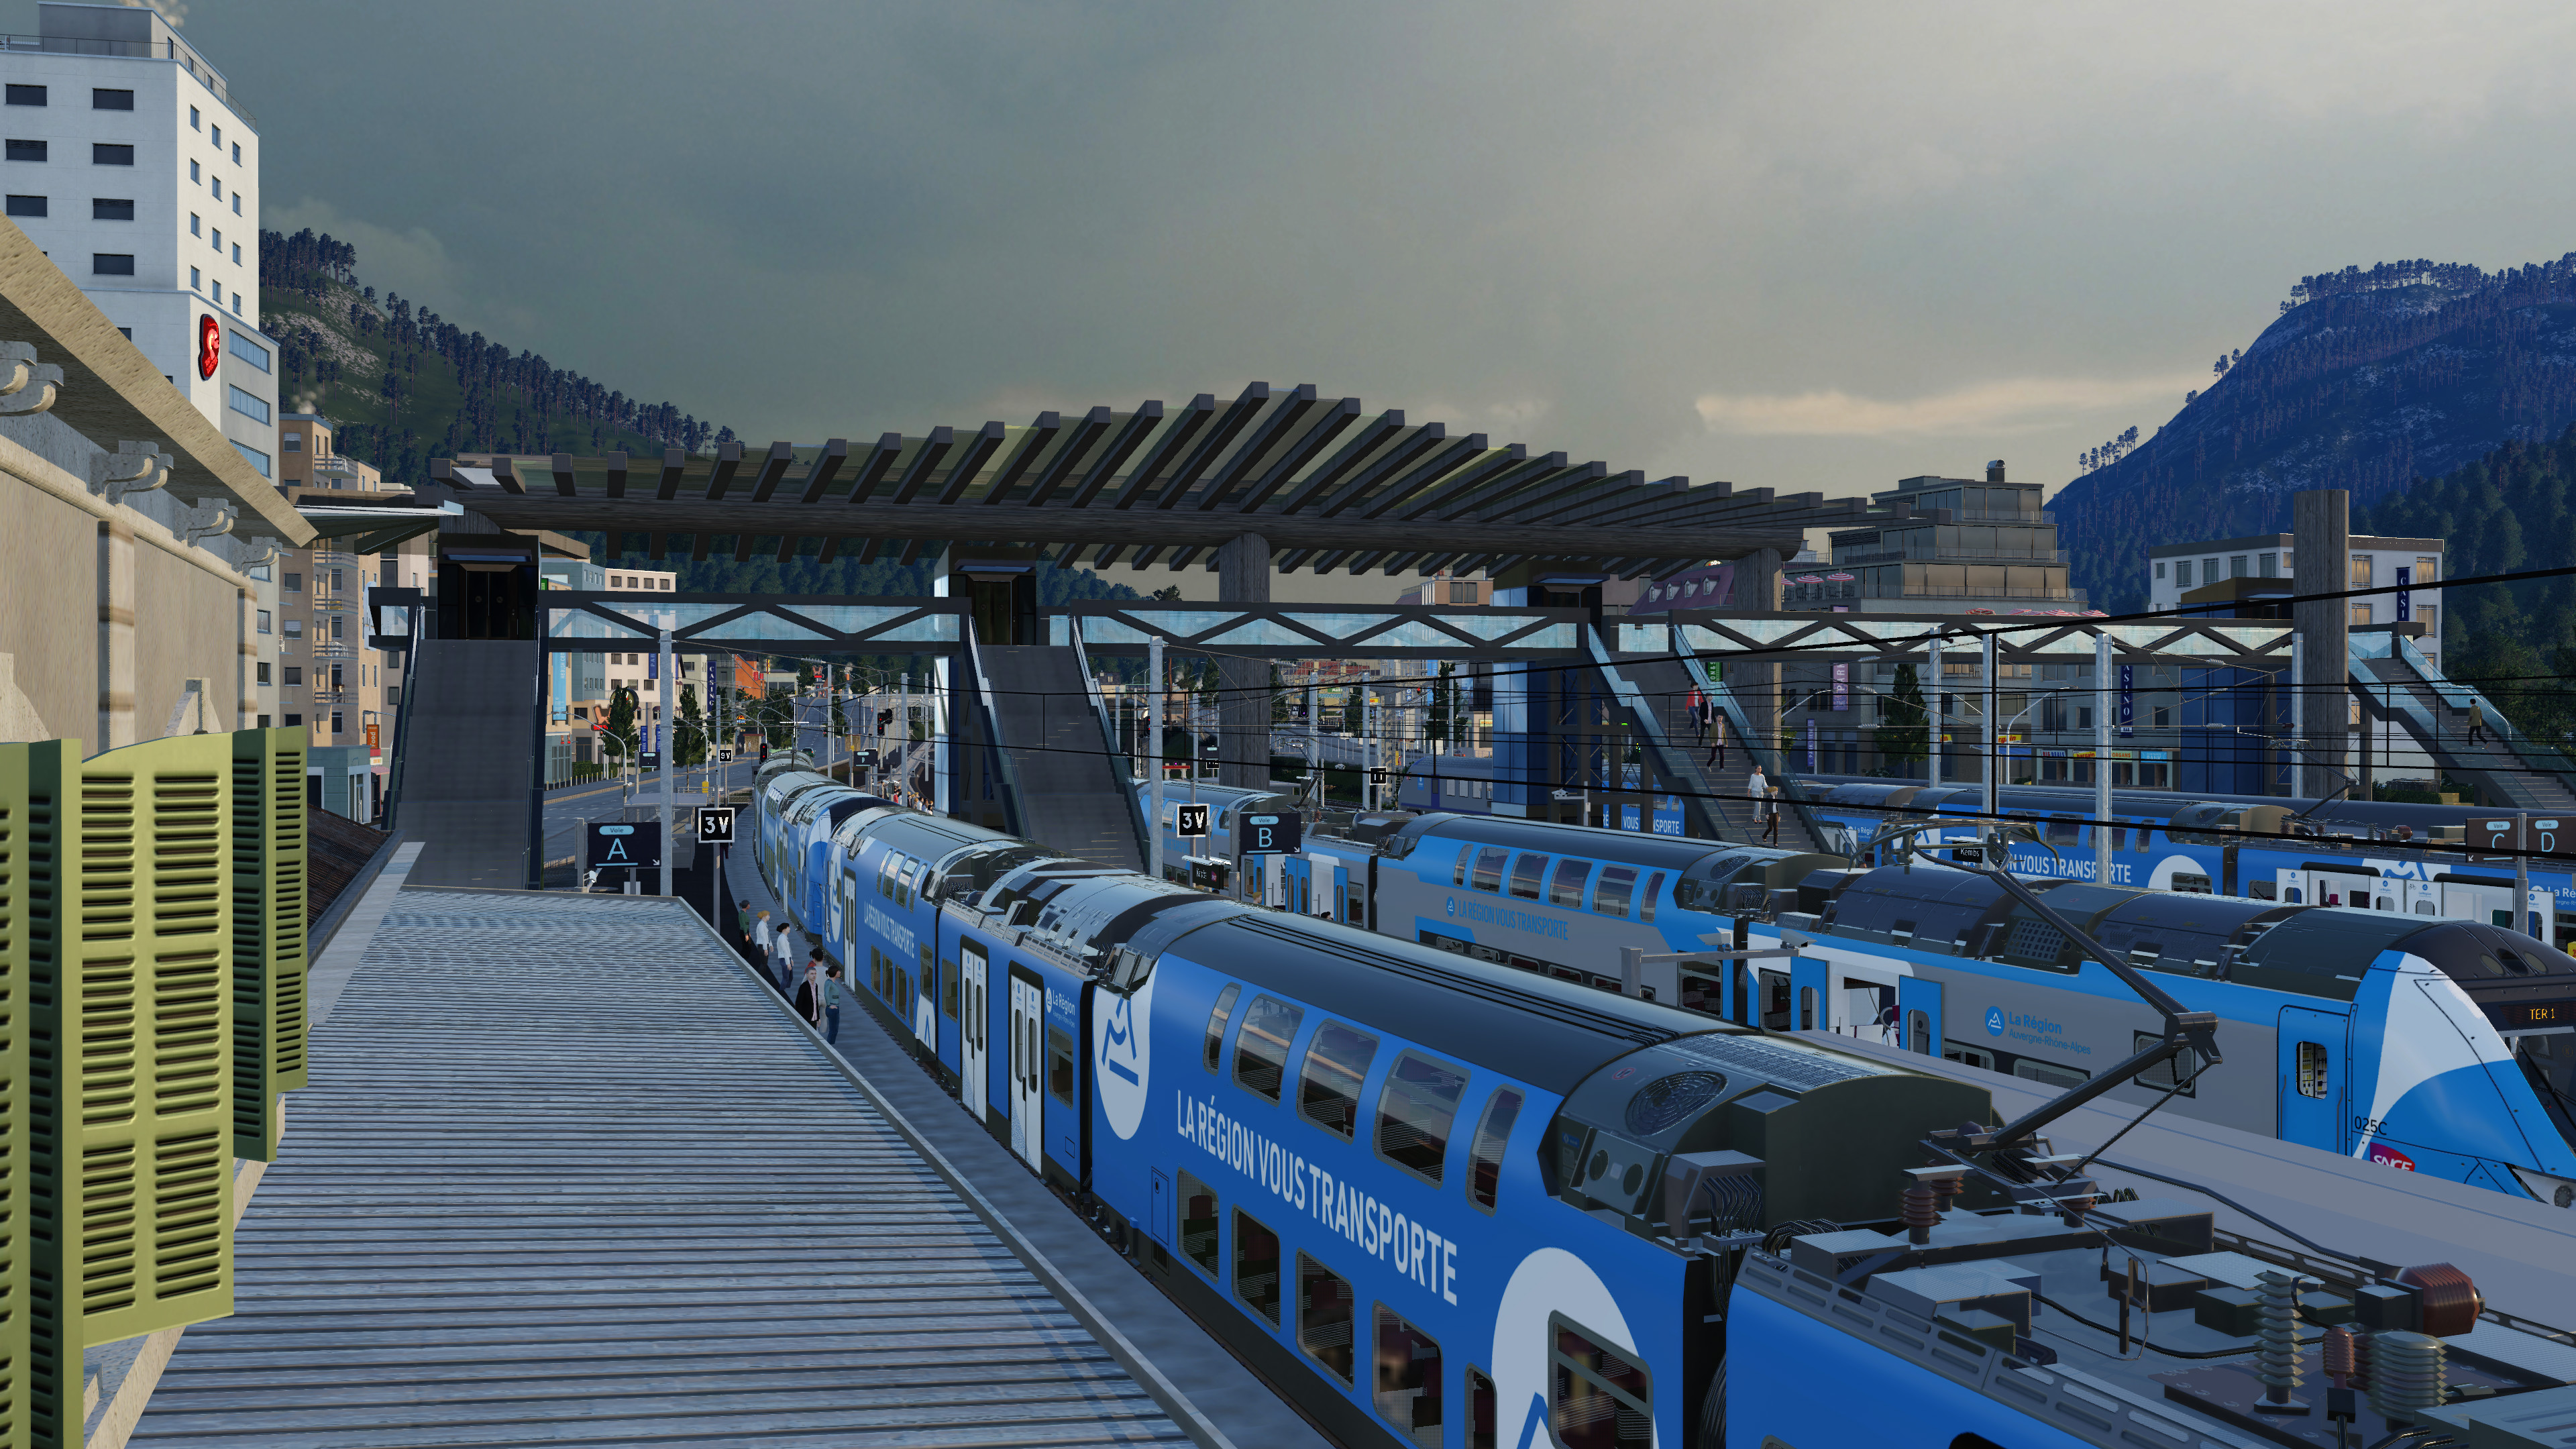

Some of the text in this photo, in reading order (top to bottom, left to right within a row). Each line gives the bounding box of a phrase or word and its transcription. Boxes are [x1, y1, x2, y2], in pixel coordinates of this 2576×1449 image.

[1623, 815, 1639, 830] VOUS
[1653, 818, 1680, 835] NSPORTE
[1258, 827, 1273, 848] B
[2541, 832, 2555, 853] D
[606, 838, 628, 861] A
[1960, 848, 1980, 857] Kembs
[2021, 855, 2049, 875] VOUS
[2051, 857, 2131, 883] TRANSPRTE
[864, 901, 868, 925] LA
[890, 917, 914, 959] TRANSPORTE
[1458, 899, 1568, 941] LA RÉGION VOUS TRANSPORTE
[1053, 989, 1059, 1006] La
[1059, 992, 1075, 1016] Région
[2009, 1012, 2062, 1034] La Région
[2529, 1008, 2555, 1020] TER 1
[2009, 1028, 2091, 1055] Auvergne-Rhône-Alpes
[2355, 1116, 2387, 1136] 025C
[1177, 1089, 1457, 1307] LA RÉGION VOUS TRANSPORTE
